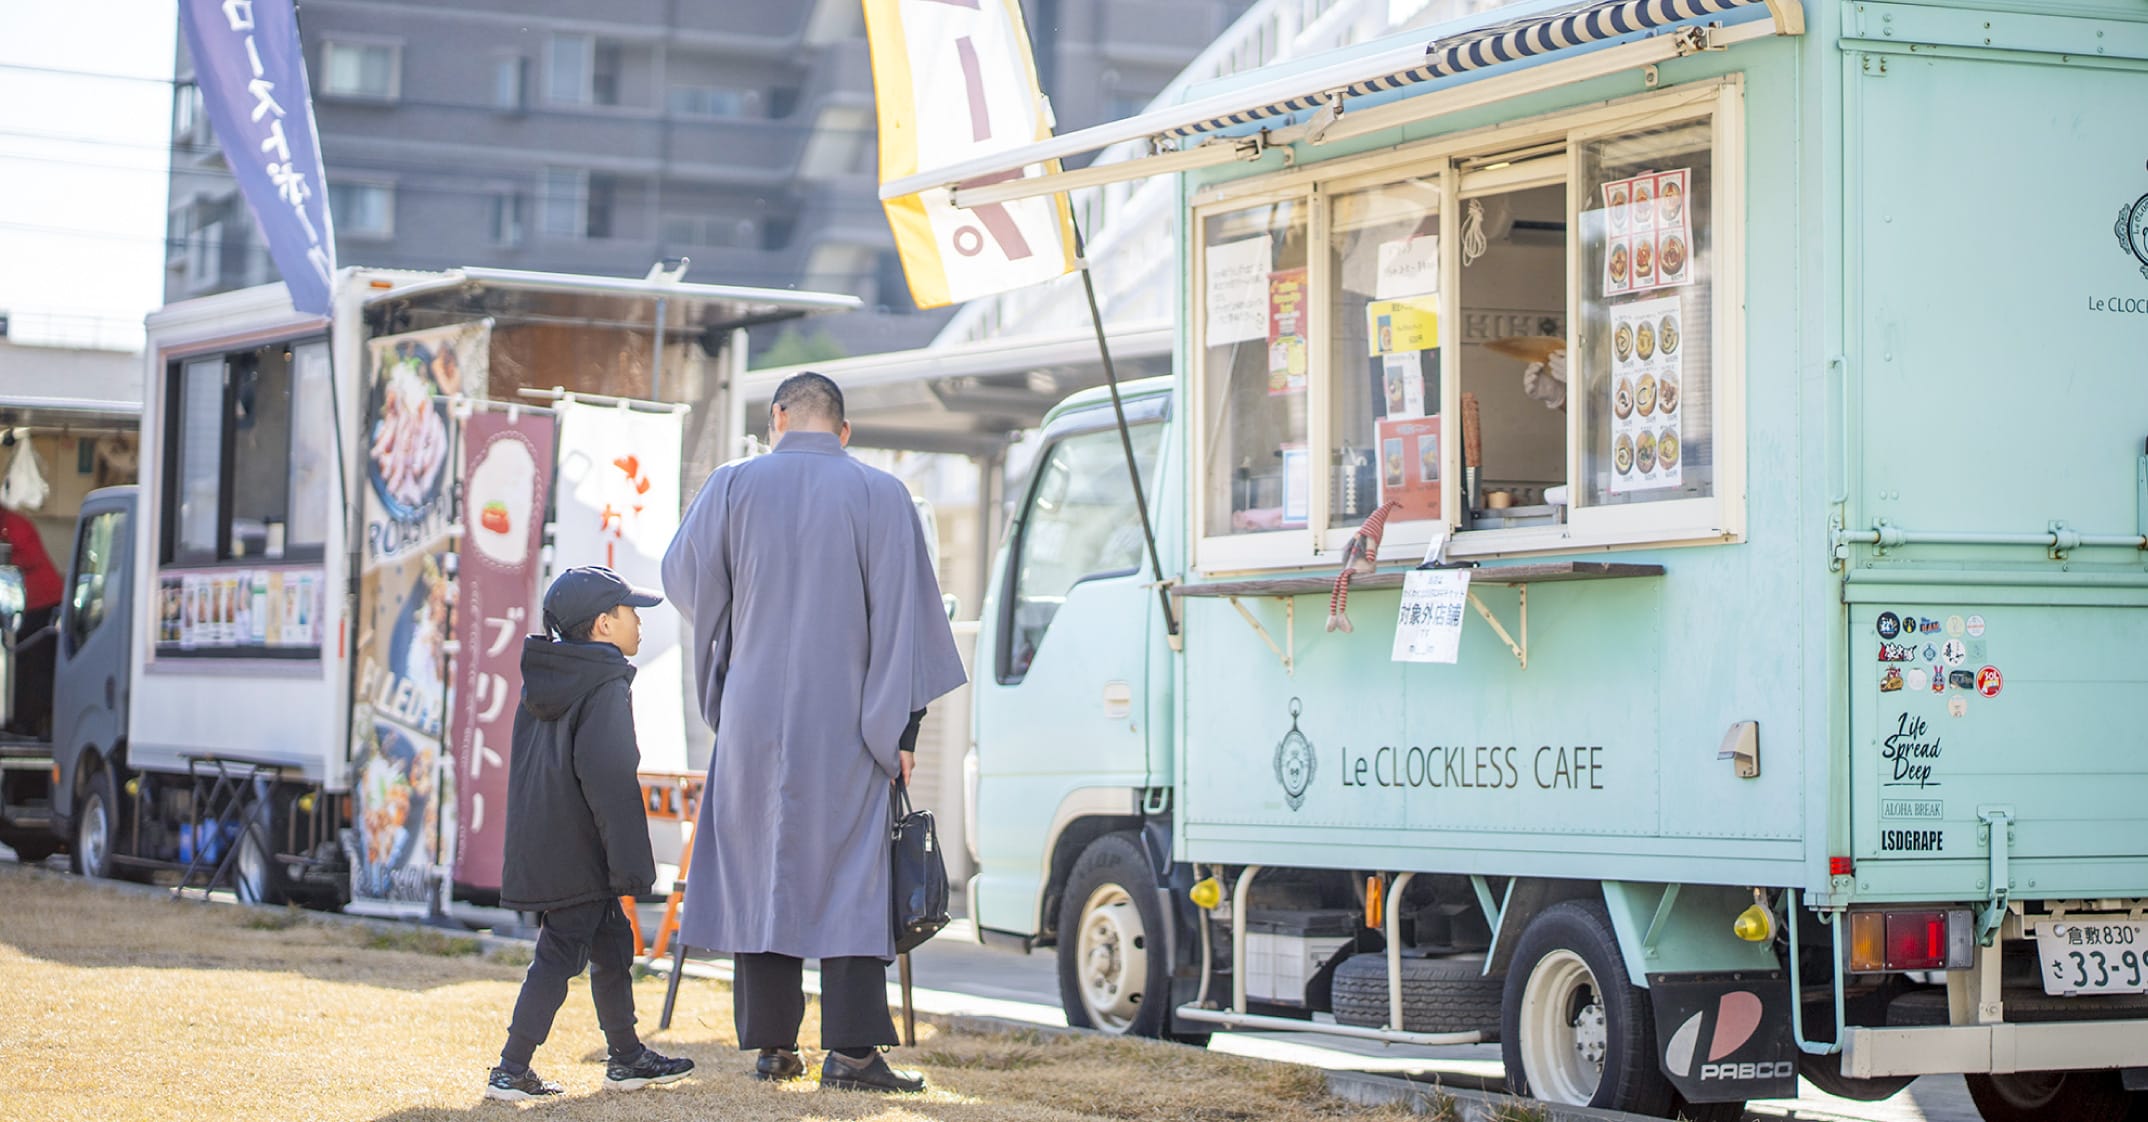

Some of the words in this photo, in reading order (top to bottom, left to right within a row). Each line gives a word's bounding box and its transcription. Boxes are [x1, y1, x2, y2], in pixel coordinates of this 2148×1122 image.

[2088, 295, 2104, 311] Le
[1399, 602, 1462, 627] 対象外店舗
[470, 606, 526, 833] ブリトー
[1898, 712, 1928, 740] Life
[1882, 734, 1942, 761] Spread
[1342, 746, 1368, 787] Le
[1375, 746, 1518, 789] CLOCKLESS
[1534, 746, 1604, 790] CAFE
[1891, 756, 1932, 790] Deep
[1884, 803, 1912, 816] ALOHA
[1914, 803, 1941, 817] BREAK
[1881, 830, 1943, 851] LSDGRAPE
[2052, 959, 2063, 980] さ
[1700, 1061, 1793, 1081] PABCO
